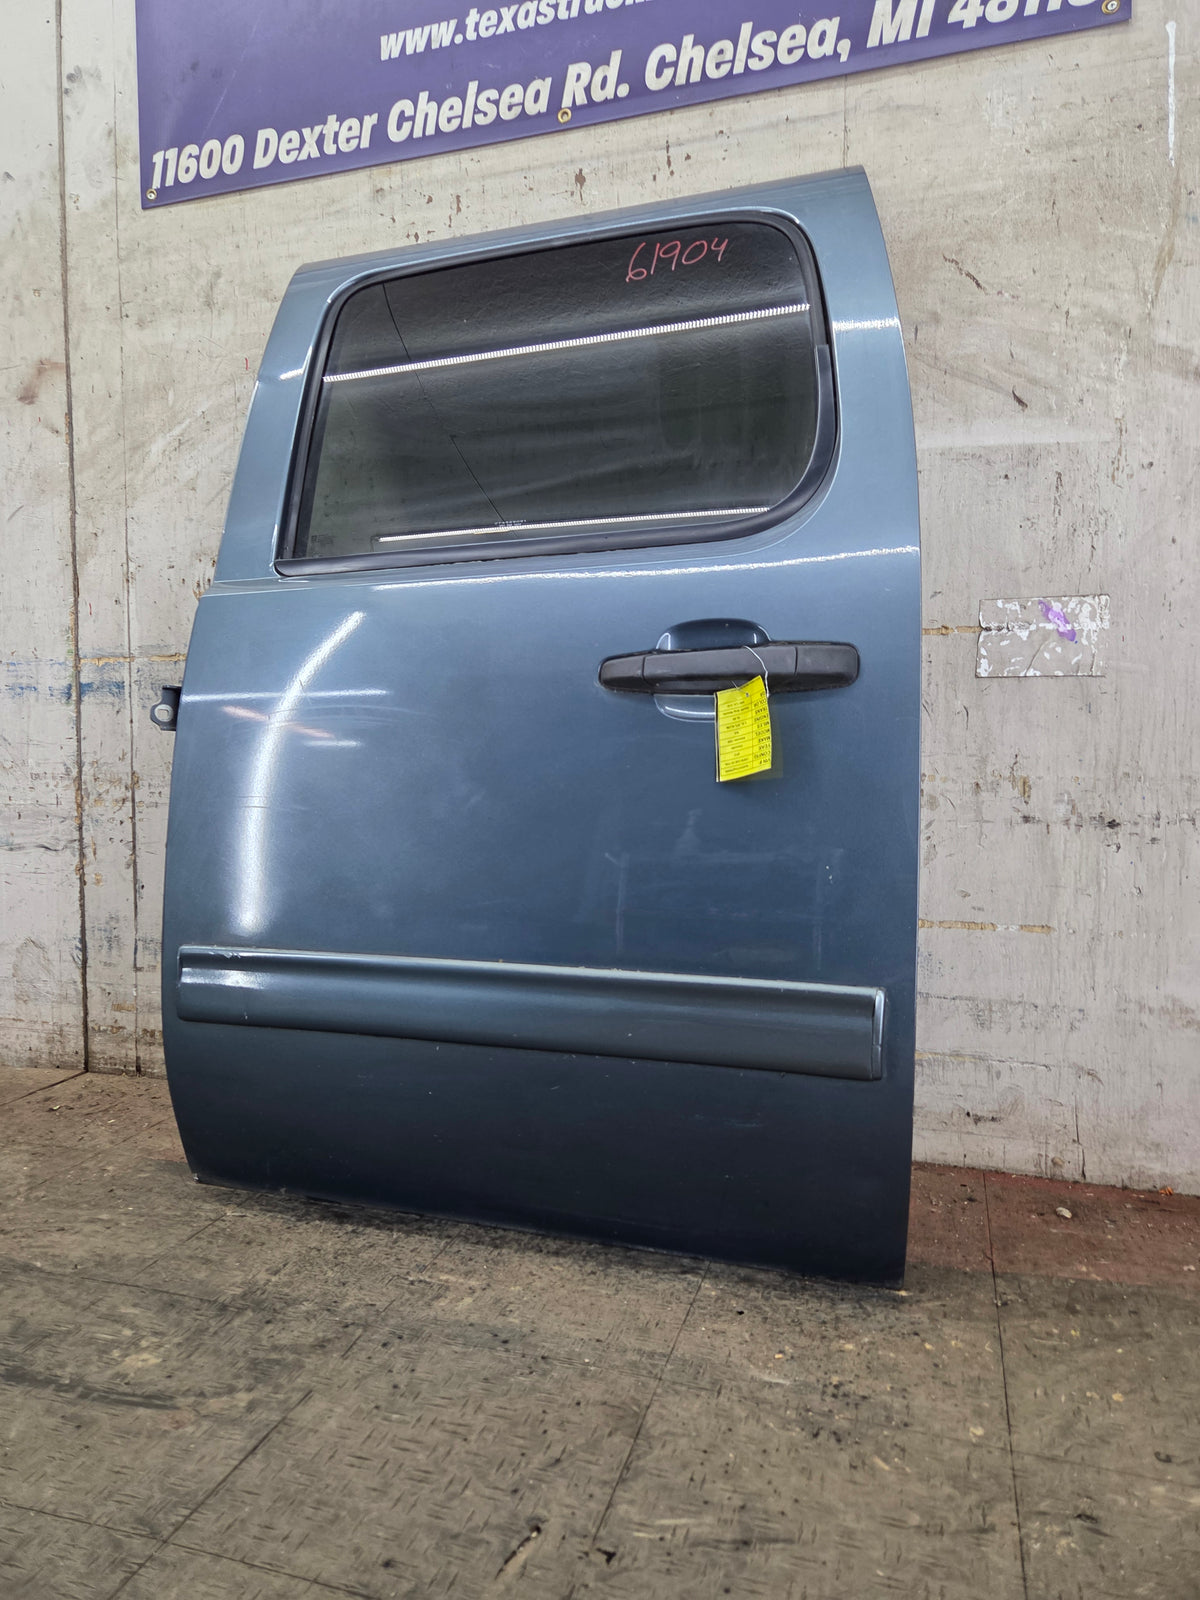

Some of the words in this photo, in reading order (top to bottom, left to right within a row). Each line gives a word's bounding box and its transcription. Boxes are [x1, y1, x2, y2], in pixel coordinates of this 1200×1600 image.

[151, 134, 245, 189] 11600
[253, 112, 378, 169] Dexter
[387, 77, 552, 143] Chelsea
[561, 49, 630, 108] Rd.
[645, 16, 851, 92] Chelsea,
[866, 0, 937, 48] MI
[625, 237, 729, 282] 61904
